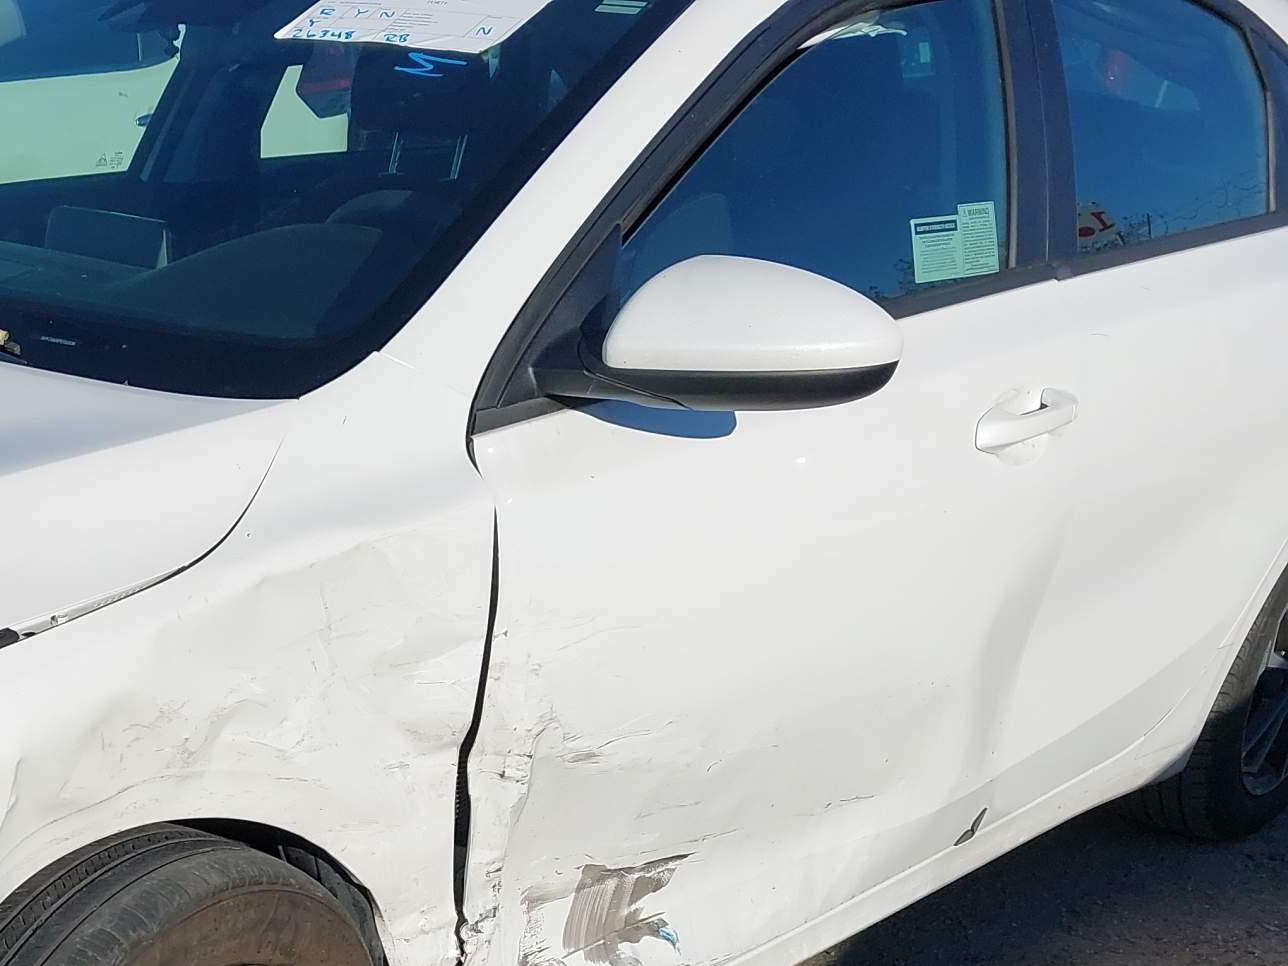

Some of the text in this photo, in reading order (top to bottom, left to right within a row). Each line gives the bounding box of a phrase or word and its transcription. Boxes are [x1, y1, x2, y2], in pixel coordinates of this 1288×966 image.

[354, 7, 369, 17] Y
[379, 10, 396, 19] N
[476, 25, 493, 37] N
